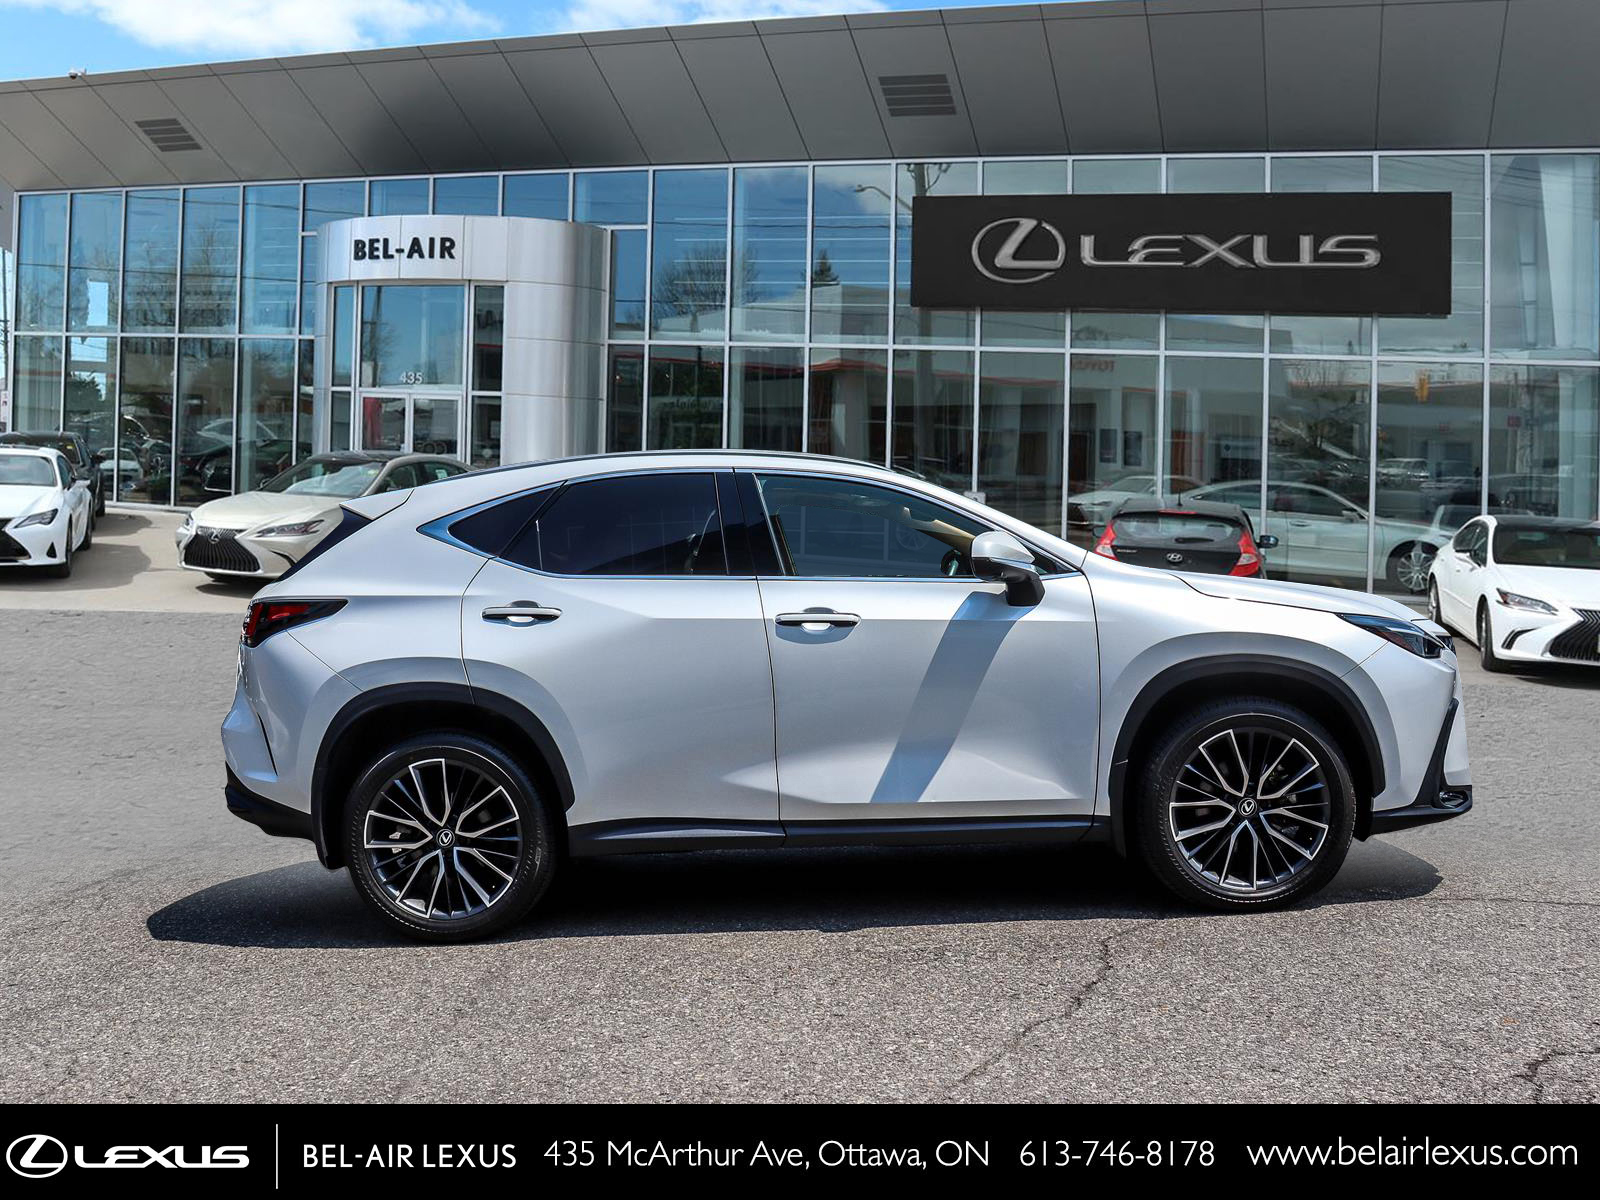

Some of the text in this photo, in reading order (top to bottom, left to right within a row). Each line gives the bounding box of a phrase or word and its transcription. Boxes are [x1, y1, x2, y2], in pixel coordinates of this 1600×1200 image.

[353, 236, 456, 261] BEL-AIR
[1080, 234, 1382, 268] LEXUS
[400, 370, 423, 385] 435
